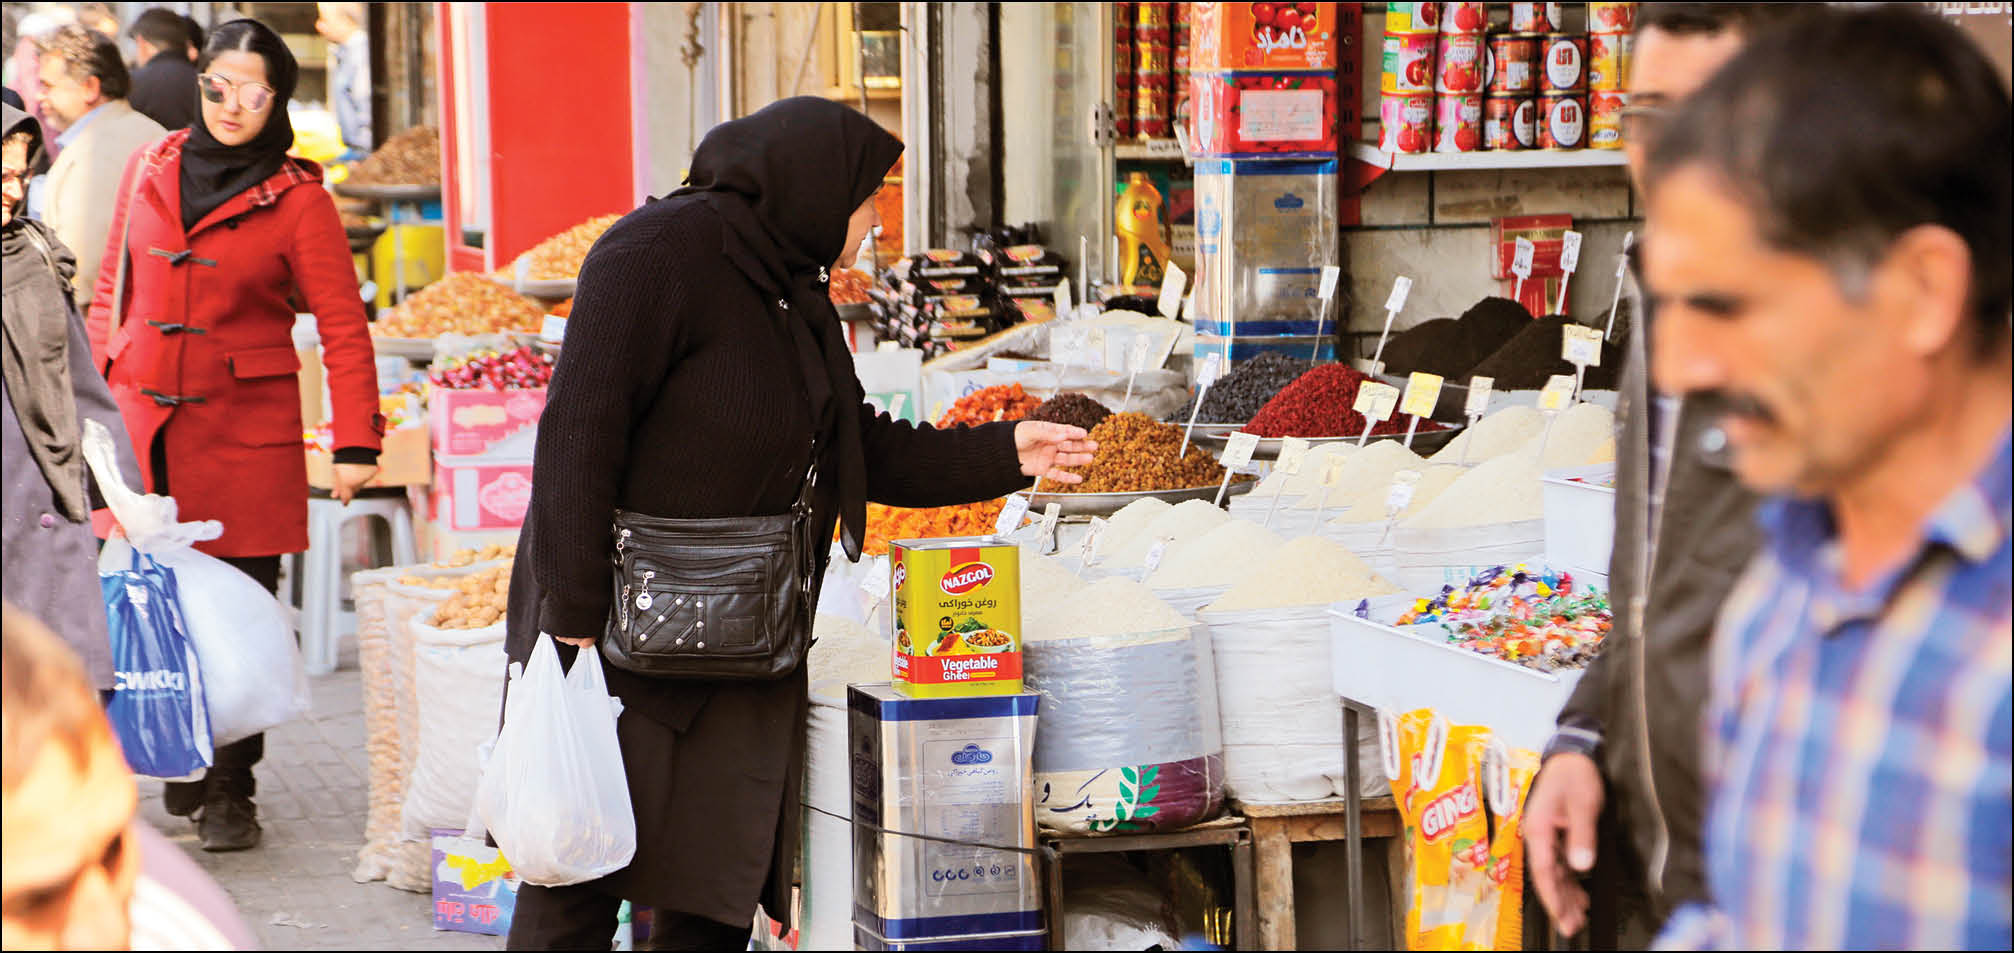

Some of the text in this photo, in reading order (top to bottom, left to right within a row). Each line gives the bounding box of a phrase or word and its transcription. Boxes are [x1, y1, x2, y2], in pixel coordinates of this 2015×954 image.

[1257, 25, 1306, 54] نامزد
[943, 567, 992, 590] NAZGOL
[939, 598, 997, 610] روغن خوراکی
[941, 656, 998, 672] Vegetable
[943, 671, 969, 680] Ghee
